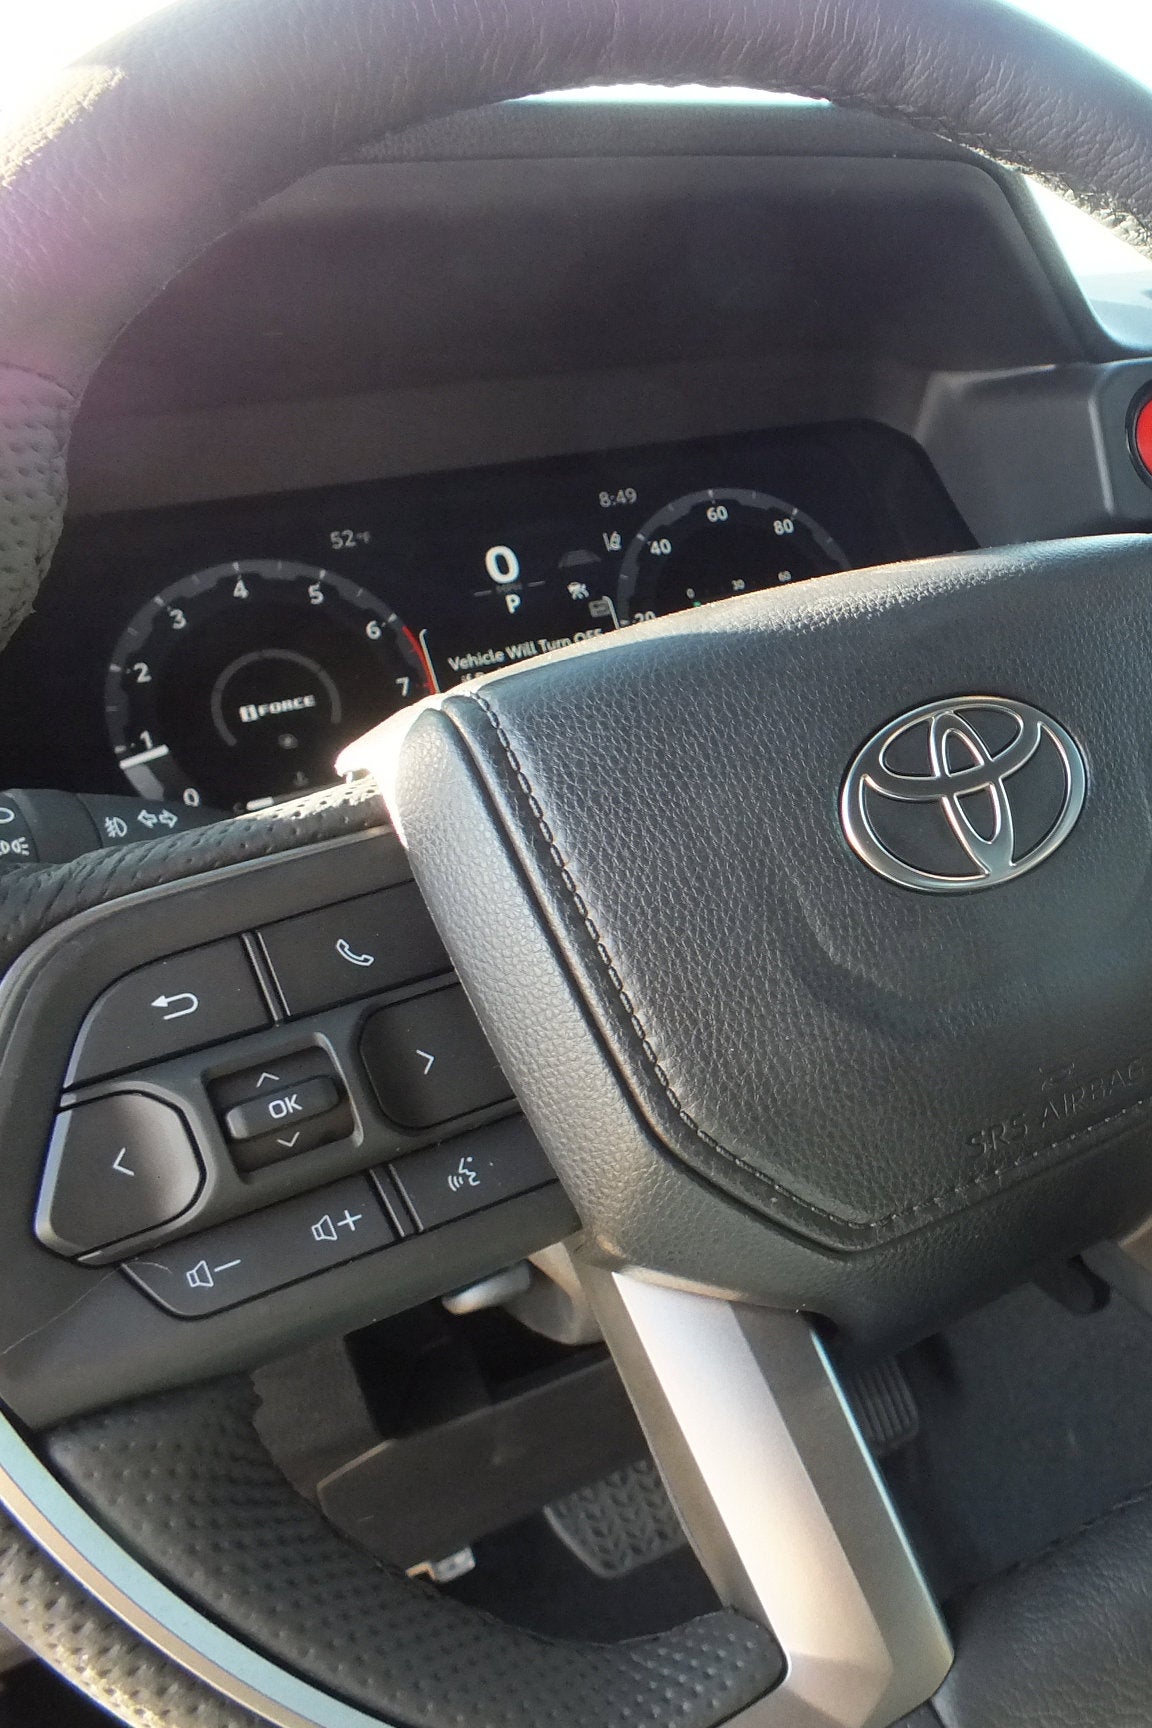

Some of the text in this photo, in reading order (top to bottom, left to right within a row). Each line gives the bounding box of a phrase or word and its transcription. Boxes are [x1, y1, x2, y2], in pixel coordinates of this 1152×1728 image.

[598, 487, 638, 508] 8:49
[705, 504, 729, 522] 60
[772, 517, 796, 536] 80
[649, 538, 673, 556] 40
[485, 545, 520, 584] 0
[233, 579, 250, 599] 4
[307, 584, 324, 605] 5
[505, 593, 521, 614] P
[169, 609, 188, 630] 3
[365, 620, 381, 640] 6
[447, 649, 506, 672] Vehicle
[505, 640, 538, 661] Will
[134, 661, 153, 684] 2
[395, 676, 410, 697] 7
[139, 730, 154, 750] 1
[183, 788, 200, 807] 0
[268, 1094, 303, 1119] OK
[970, 1056, 1144, 1154] SRS AIRBAG
